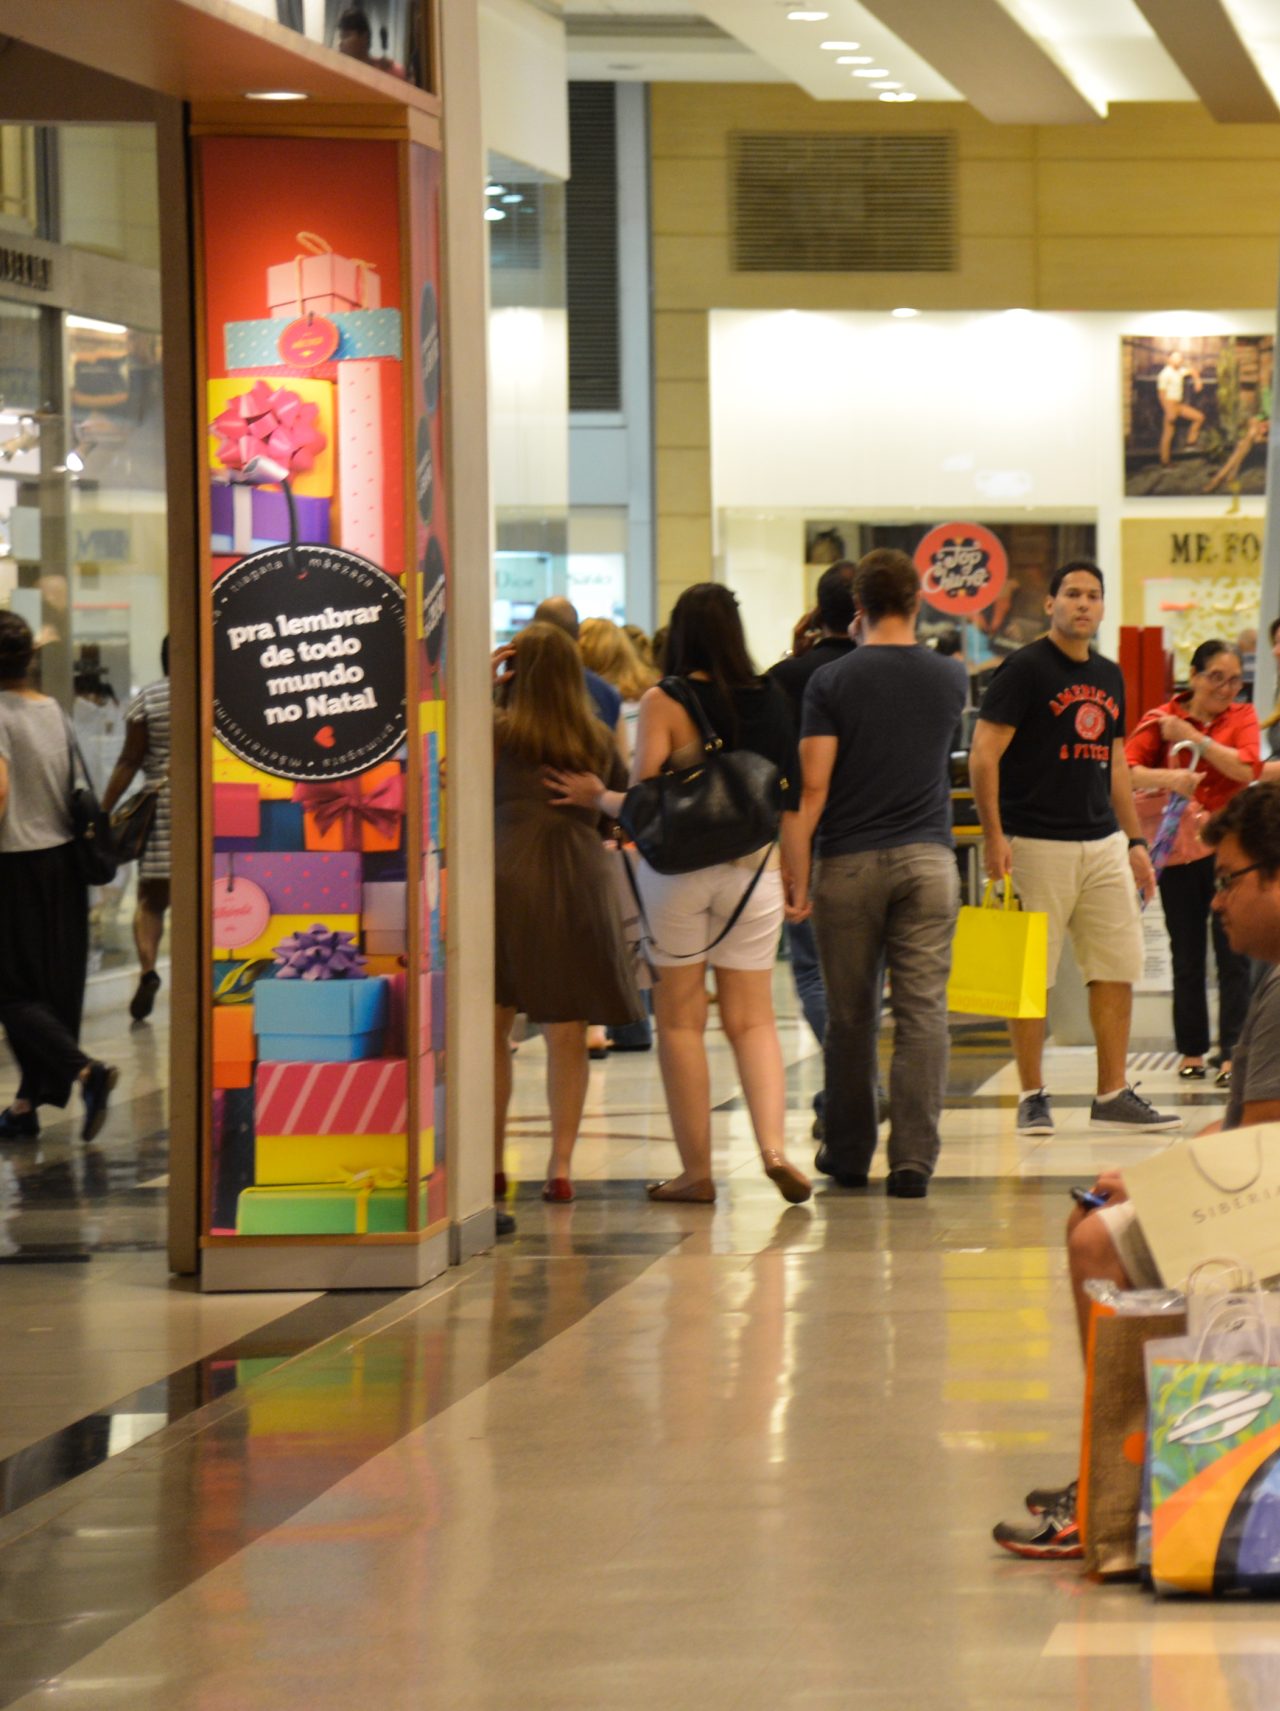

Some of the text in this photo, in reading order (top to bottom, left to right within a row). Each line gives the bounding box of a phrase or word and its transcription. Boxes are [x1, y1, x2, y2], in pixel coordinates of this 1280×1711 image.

[1224, 532, 1261, 564] FO
[227, 622, 276, 650] pra
[275, 604, 383, 639] lembrar
[259, 635, 362, 669] de todo
[266, 663, 364, 696] mundo
[263, 687, 378, 726] no Natal
